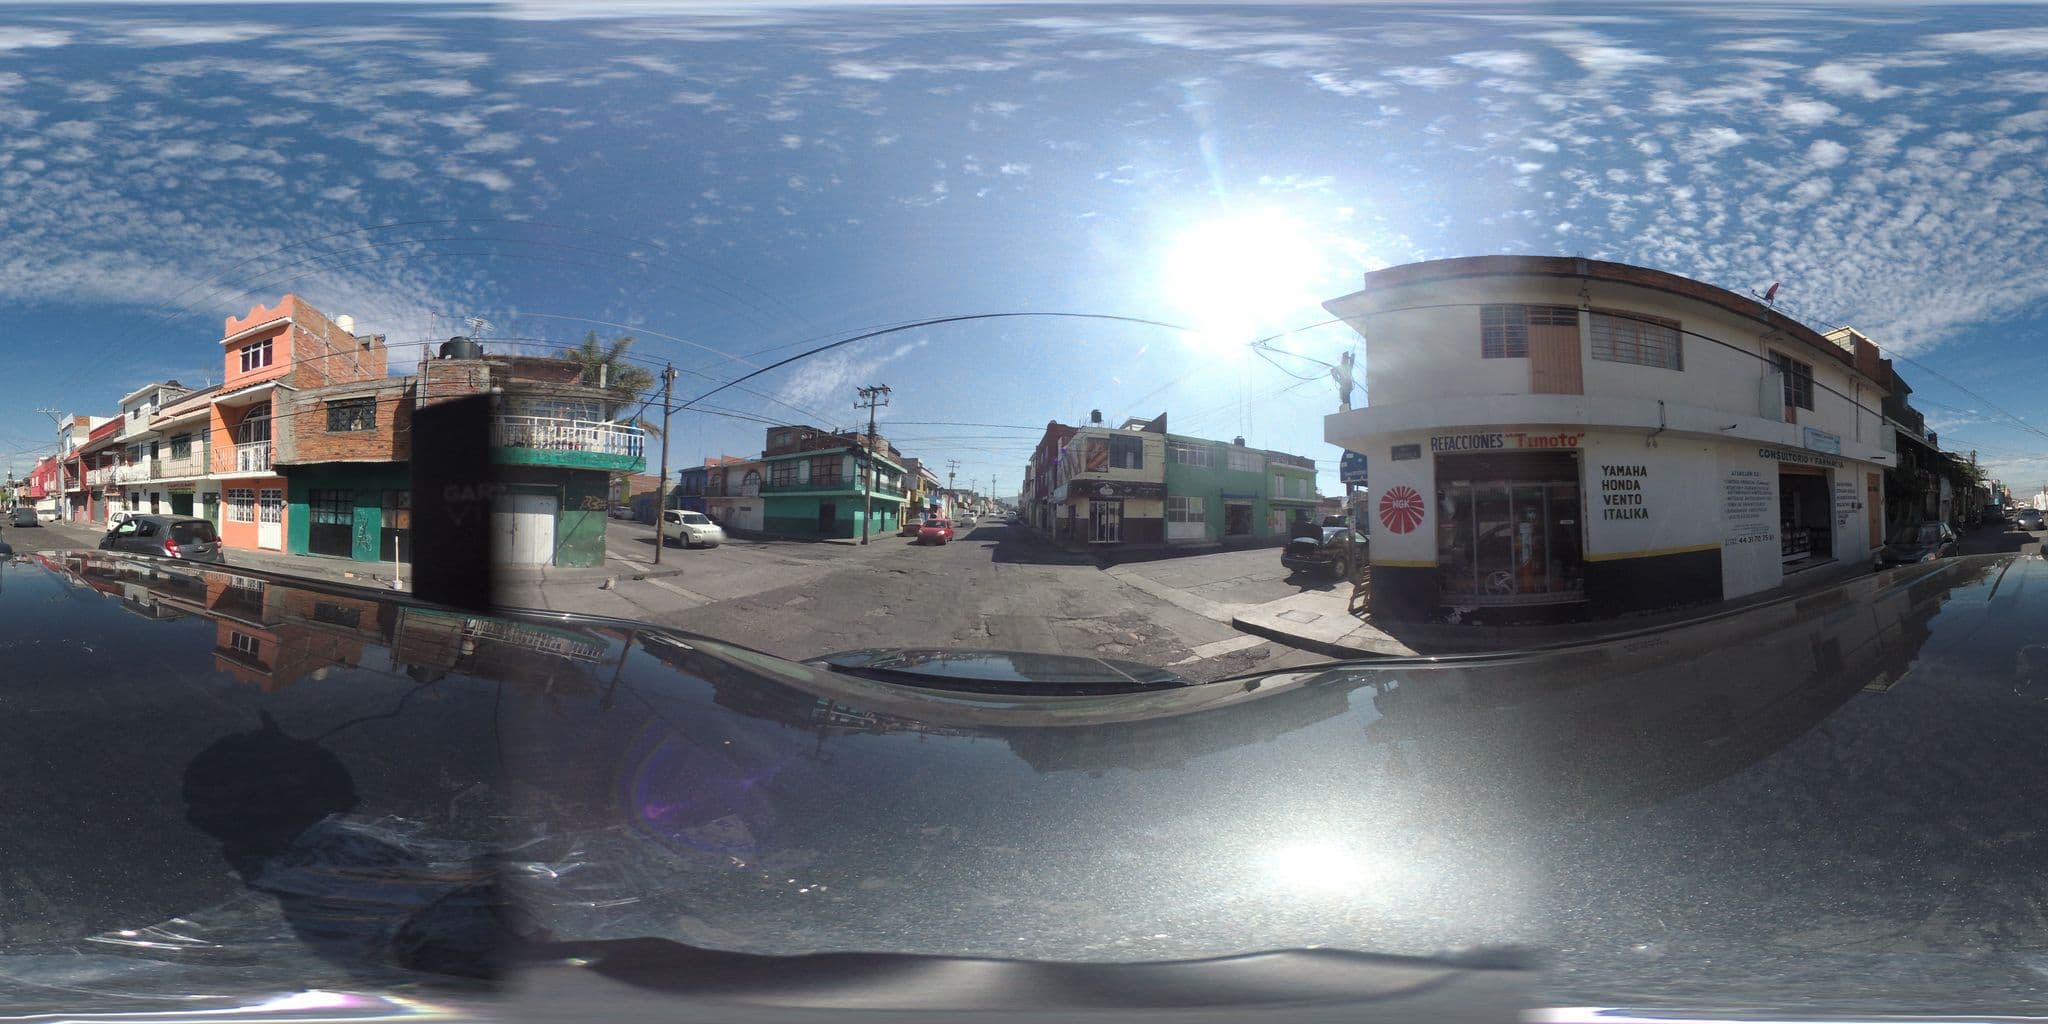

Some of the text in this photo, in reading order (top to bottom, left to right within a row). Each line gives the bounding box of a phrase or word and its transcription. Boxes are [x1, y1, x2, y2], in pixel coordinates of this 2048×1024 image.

[1431, 434, 1504, 450] REFACCIONES
[1759, 448, 1809, 464] CONSULTORIO
[1602, 465, 1647, 477] YAMAHA
[1602, 480, 1641, 491] HONDA
[1392, 499, 1410, 509] NGK
[1603, 494, 1642, 506] VENTO
[1604, 508, 1649, 520] ITALIKA
